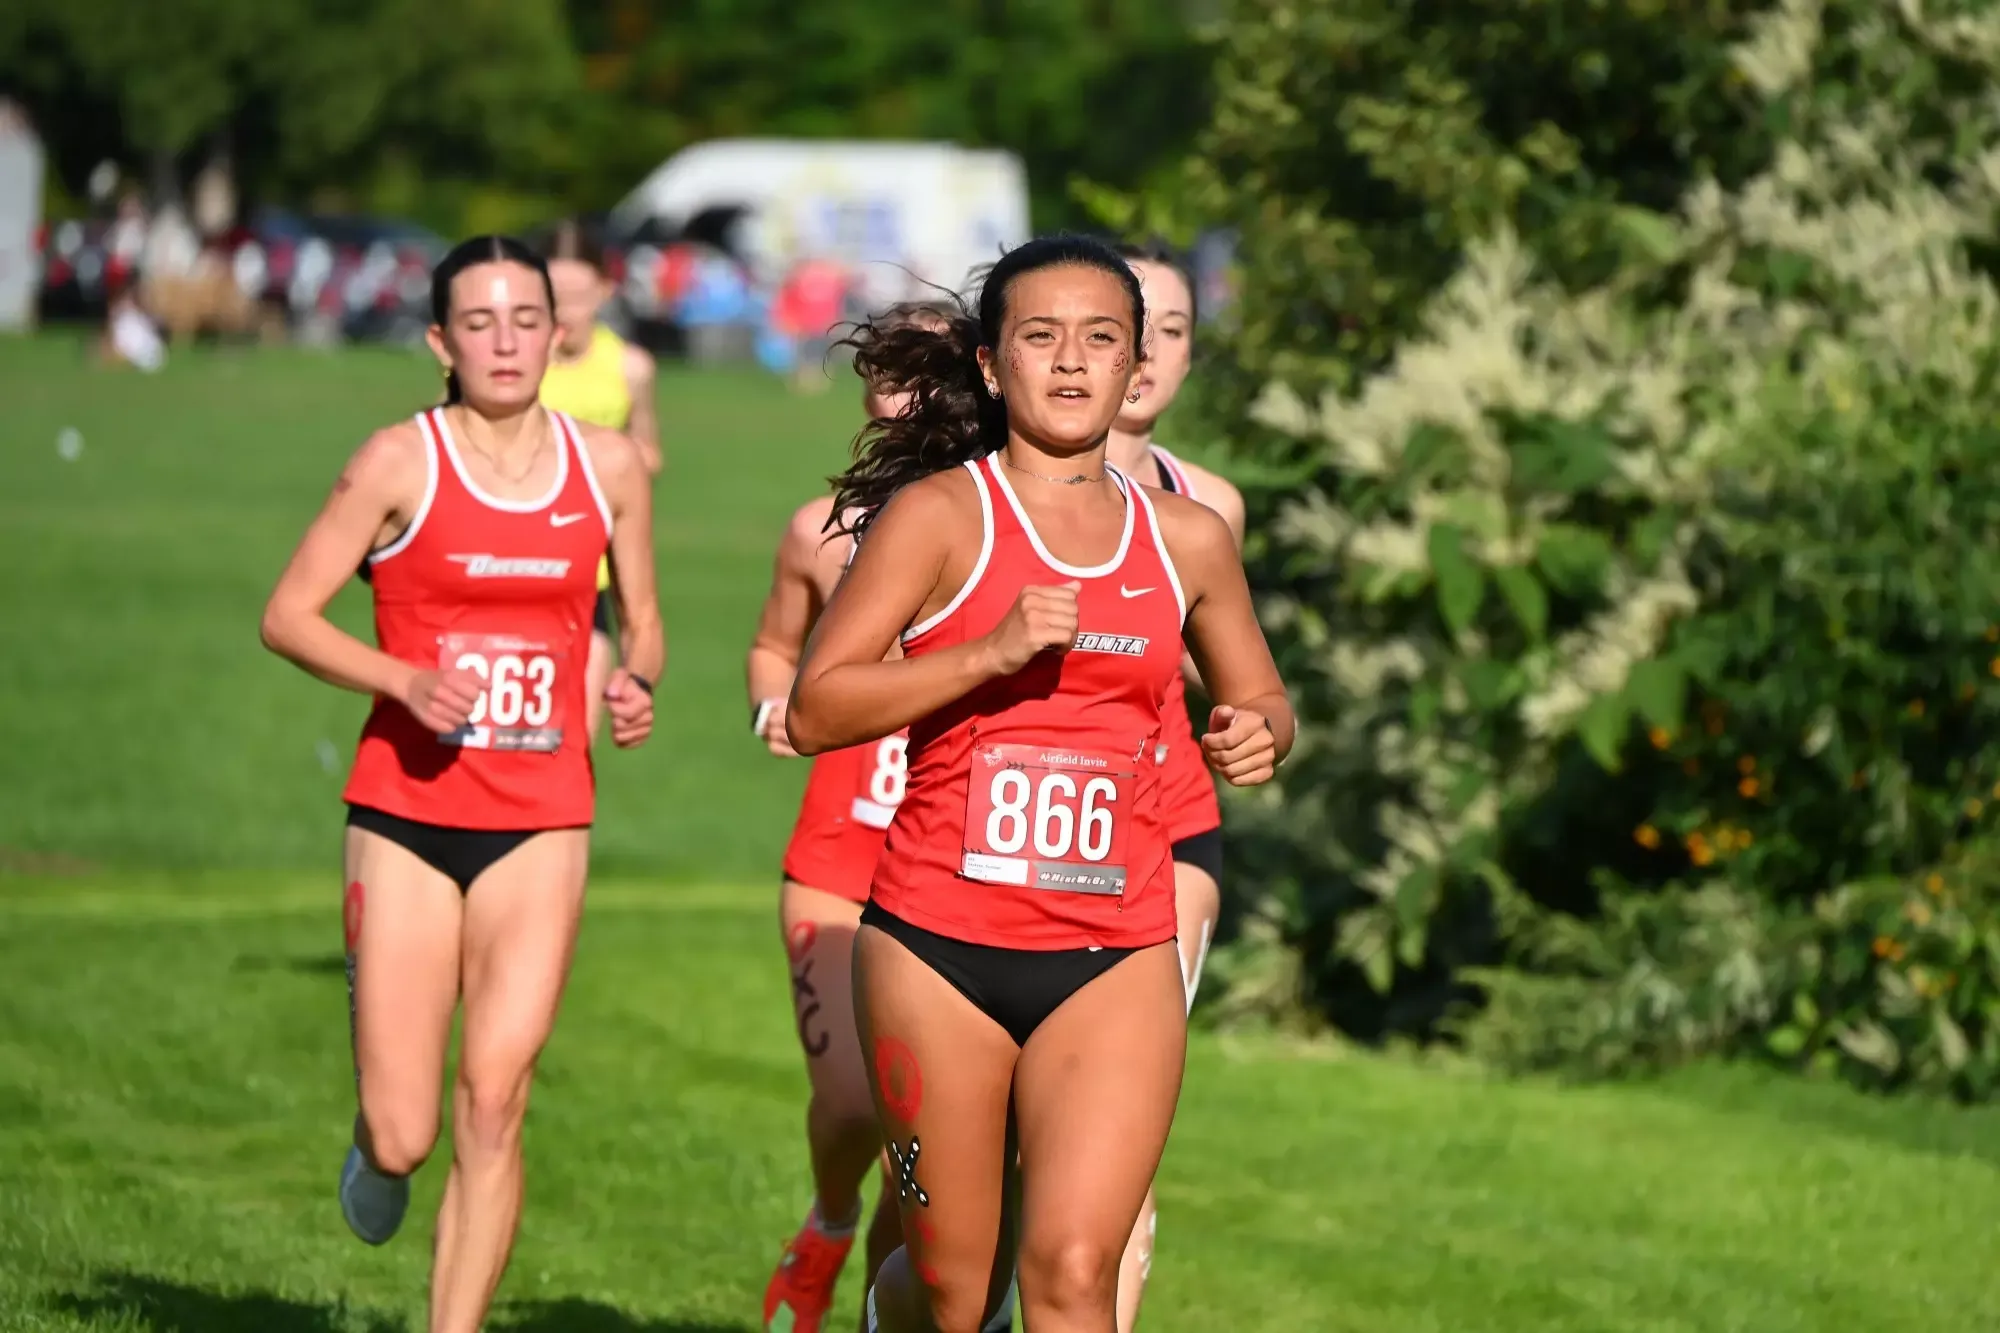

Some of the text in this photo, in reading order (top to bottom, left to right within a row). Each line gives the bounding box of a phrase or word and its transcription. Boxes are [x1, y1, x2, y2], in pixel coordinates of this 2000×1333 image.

[1075, 634, 1146, 655] EONTA
[1040, 752, 1108, 768] Airfield Invite
[985, 768, 1118, 862] 866
